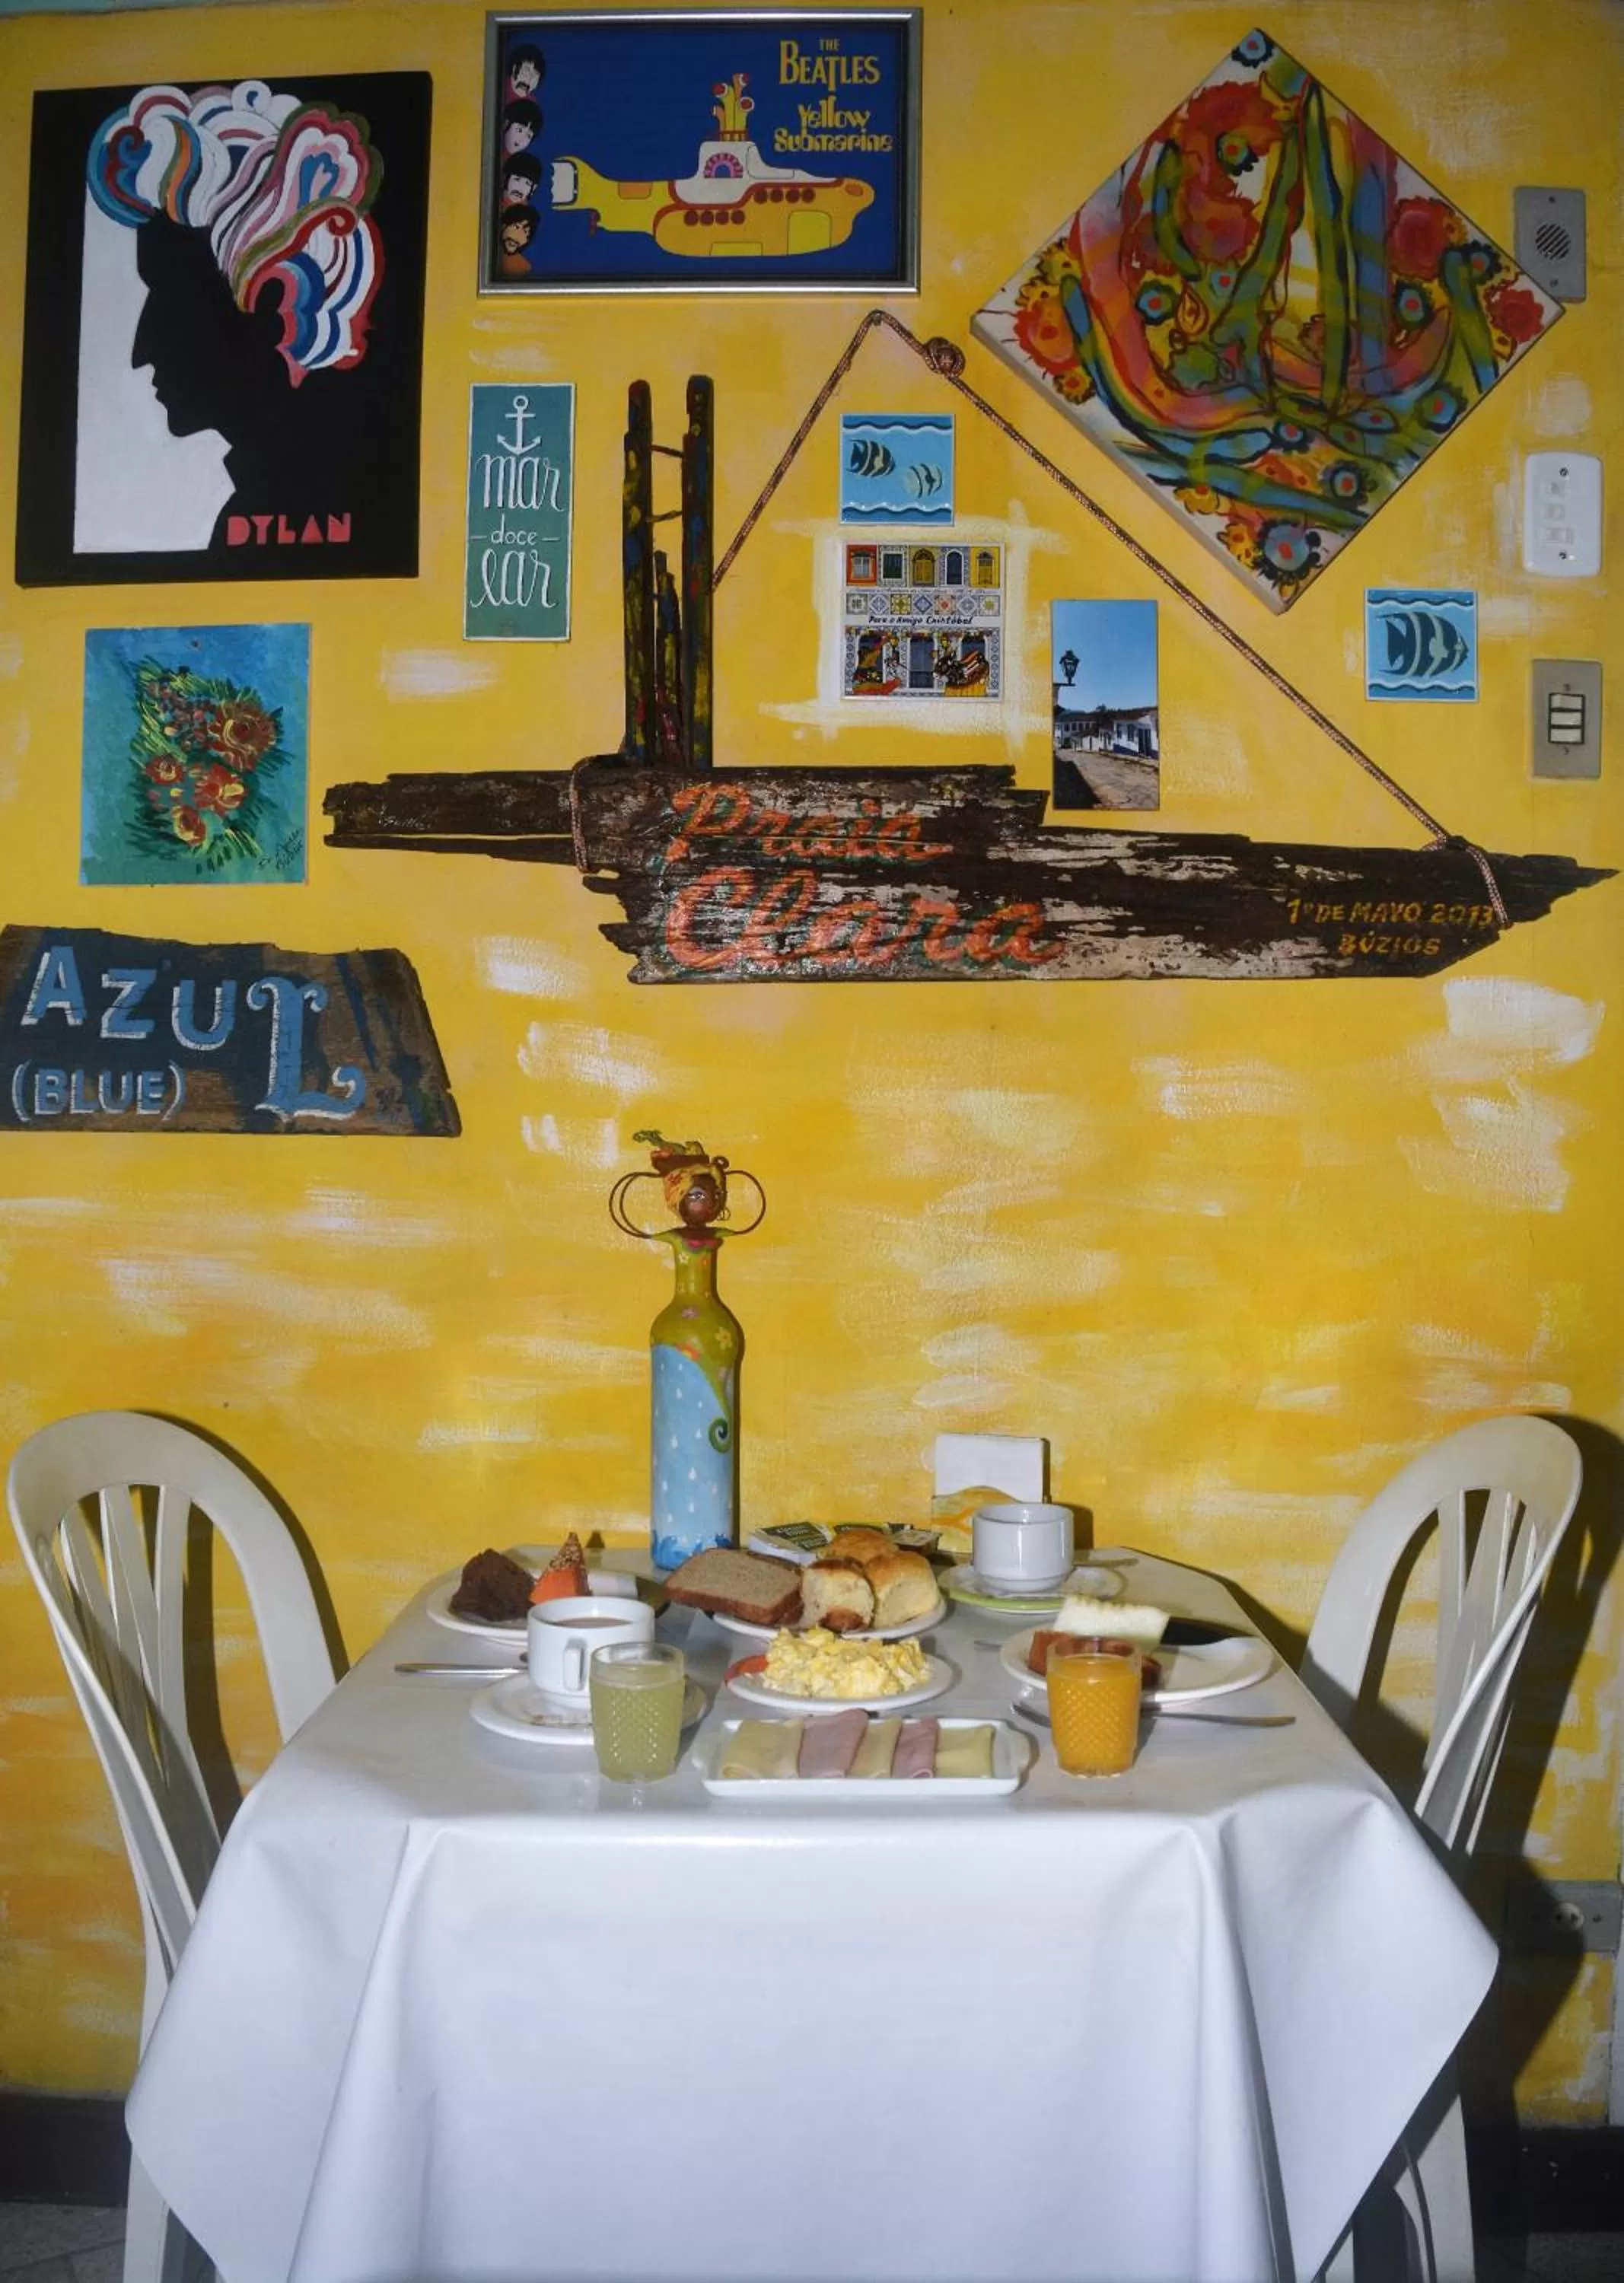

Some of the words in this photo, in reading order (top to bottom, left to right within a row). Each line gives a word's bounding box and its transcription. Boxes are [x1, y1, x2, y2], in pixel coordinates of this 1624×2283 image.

[779, 40, 880, 91] BEATLES
[820, 38, 840, 52] THE
[798, 95, 871, 132] Yellow
[774, 126, 893, 152] Submarine
[475, 453, 565, 512] mar
[227, 511, 352, 546] DYLAN
[490, 513, 537, 546] doce
[470, 548, 557, 609] lar
[664, 865, 1065, 971] Clara
[1348, 900, 1423, 924] MAYO
[1431, 903, 1495, 929] 2013
[21, 944, 367, 1122] AZUL
[11, 1059, 186, 1122] (BLUE)
